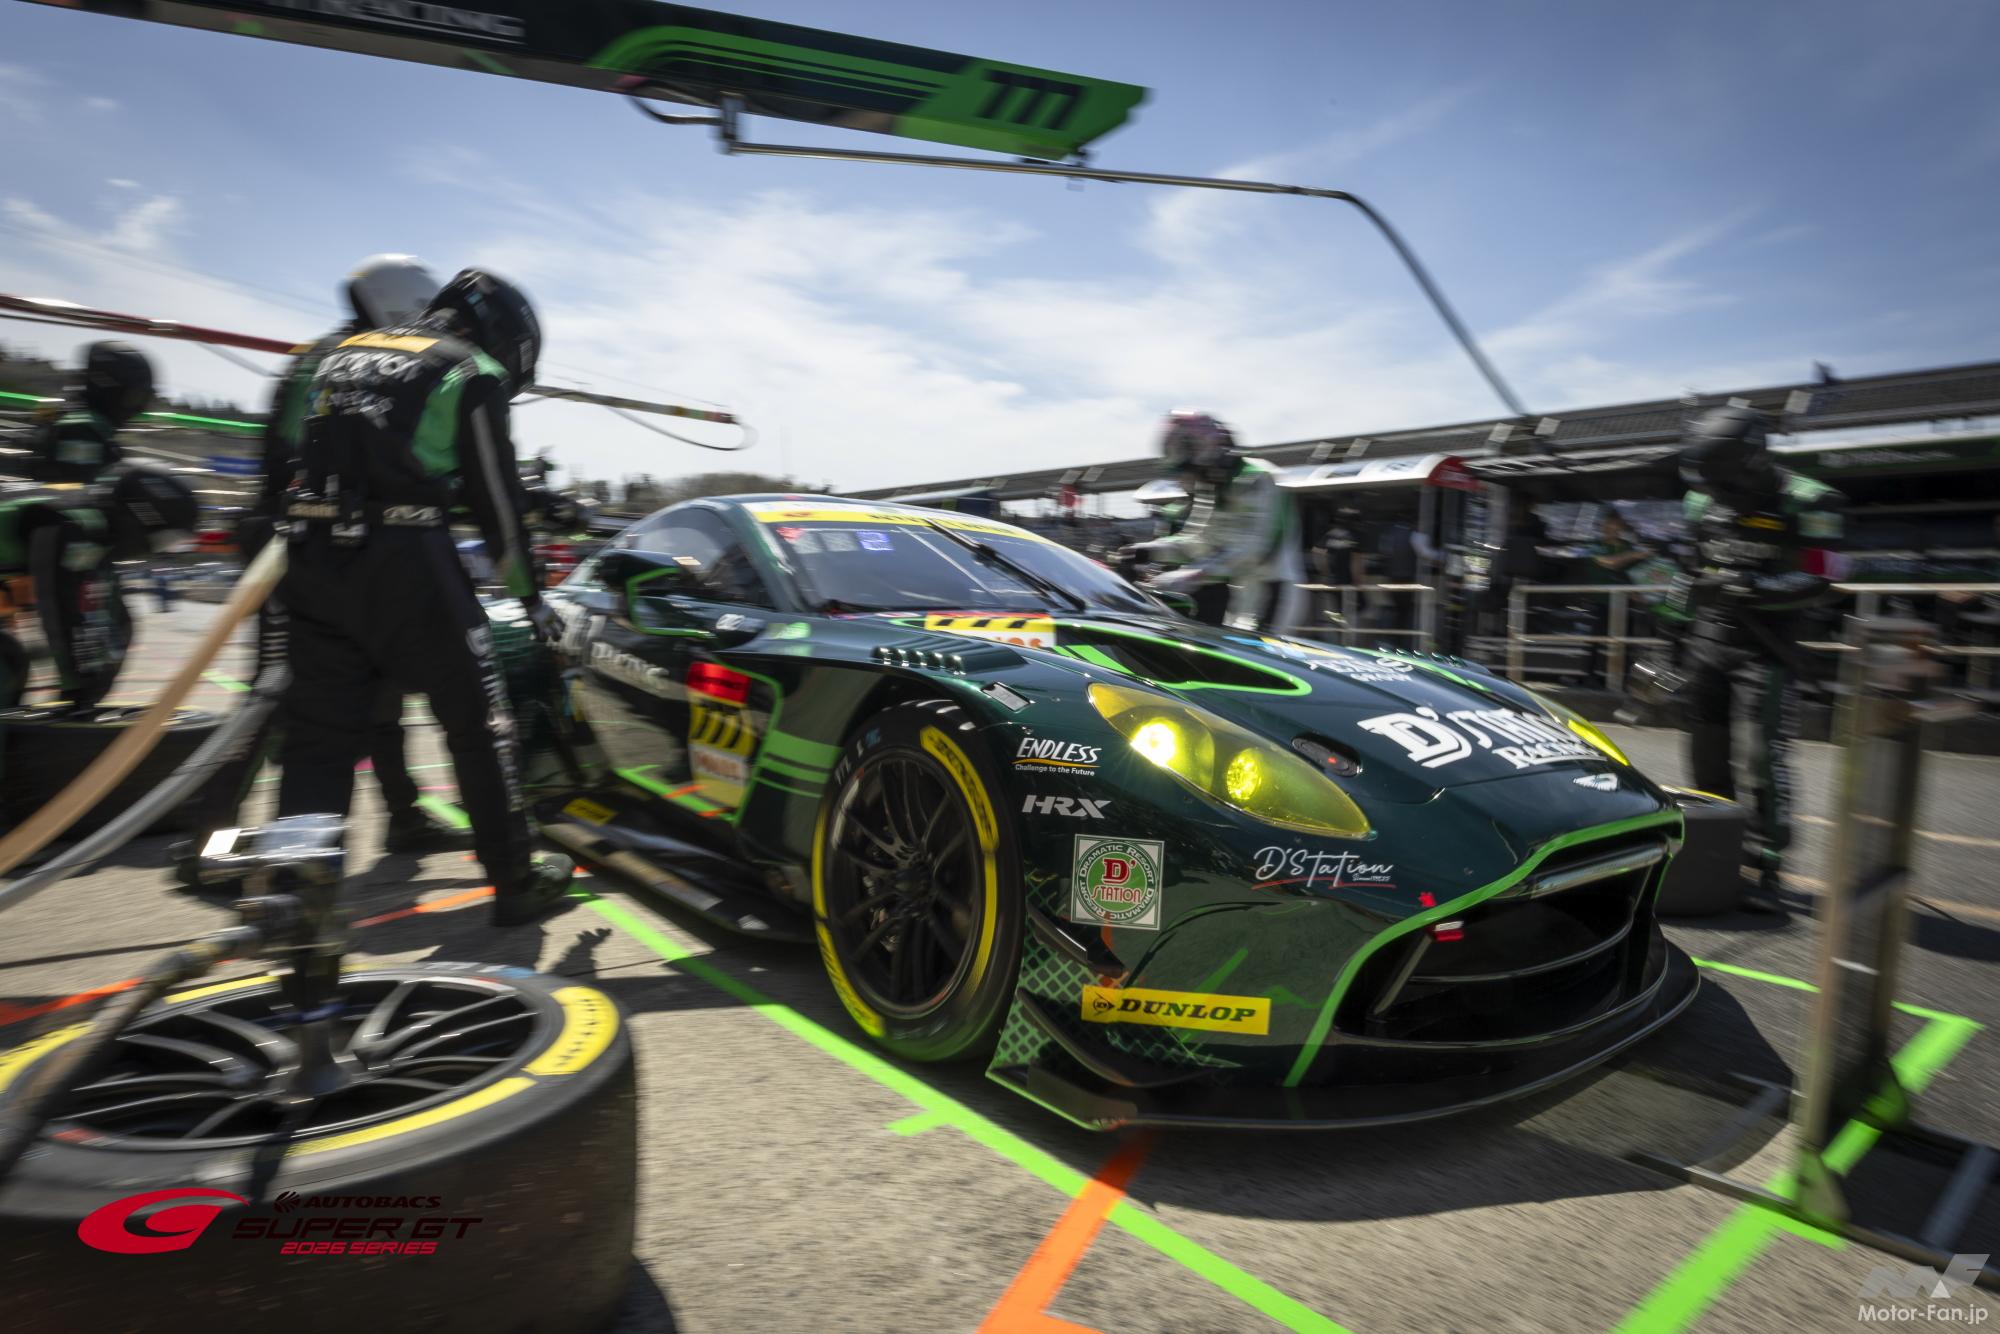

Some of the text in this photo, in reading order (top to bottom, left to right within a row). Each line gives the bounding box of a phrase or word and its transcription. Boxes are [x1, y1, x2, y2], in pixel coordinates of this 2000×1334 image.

[1016, 737, 1103, 763] ENDLESS
[1015, 764, 1048, 773] Challenge
[1071, 767, 1095, 776] Future
[1022, 794, 1112, 819] HRX
[1080, 845, 1154, 920] DRAMATIC RESORT DRAMATIC RESORT
[1101, 858, 1137, 885] D'
[1090, 885, 1142, 904] STATION
[1117, 998, 1257, 1022] DUNLOP
